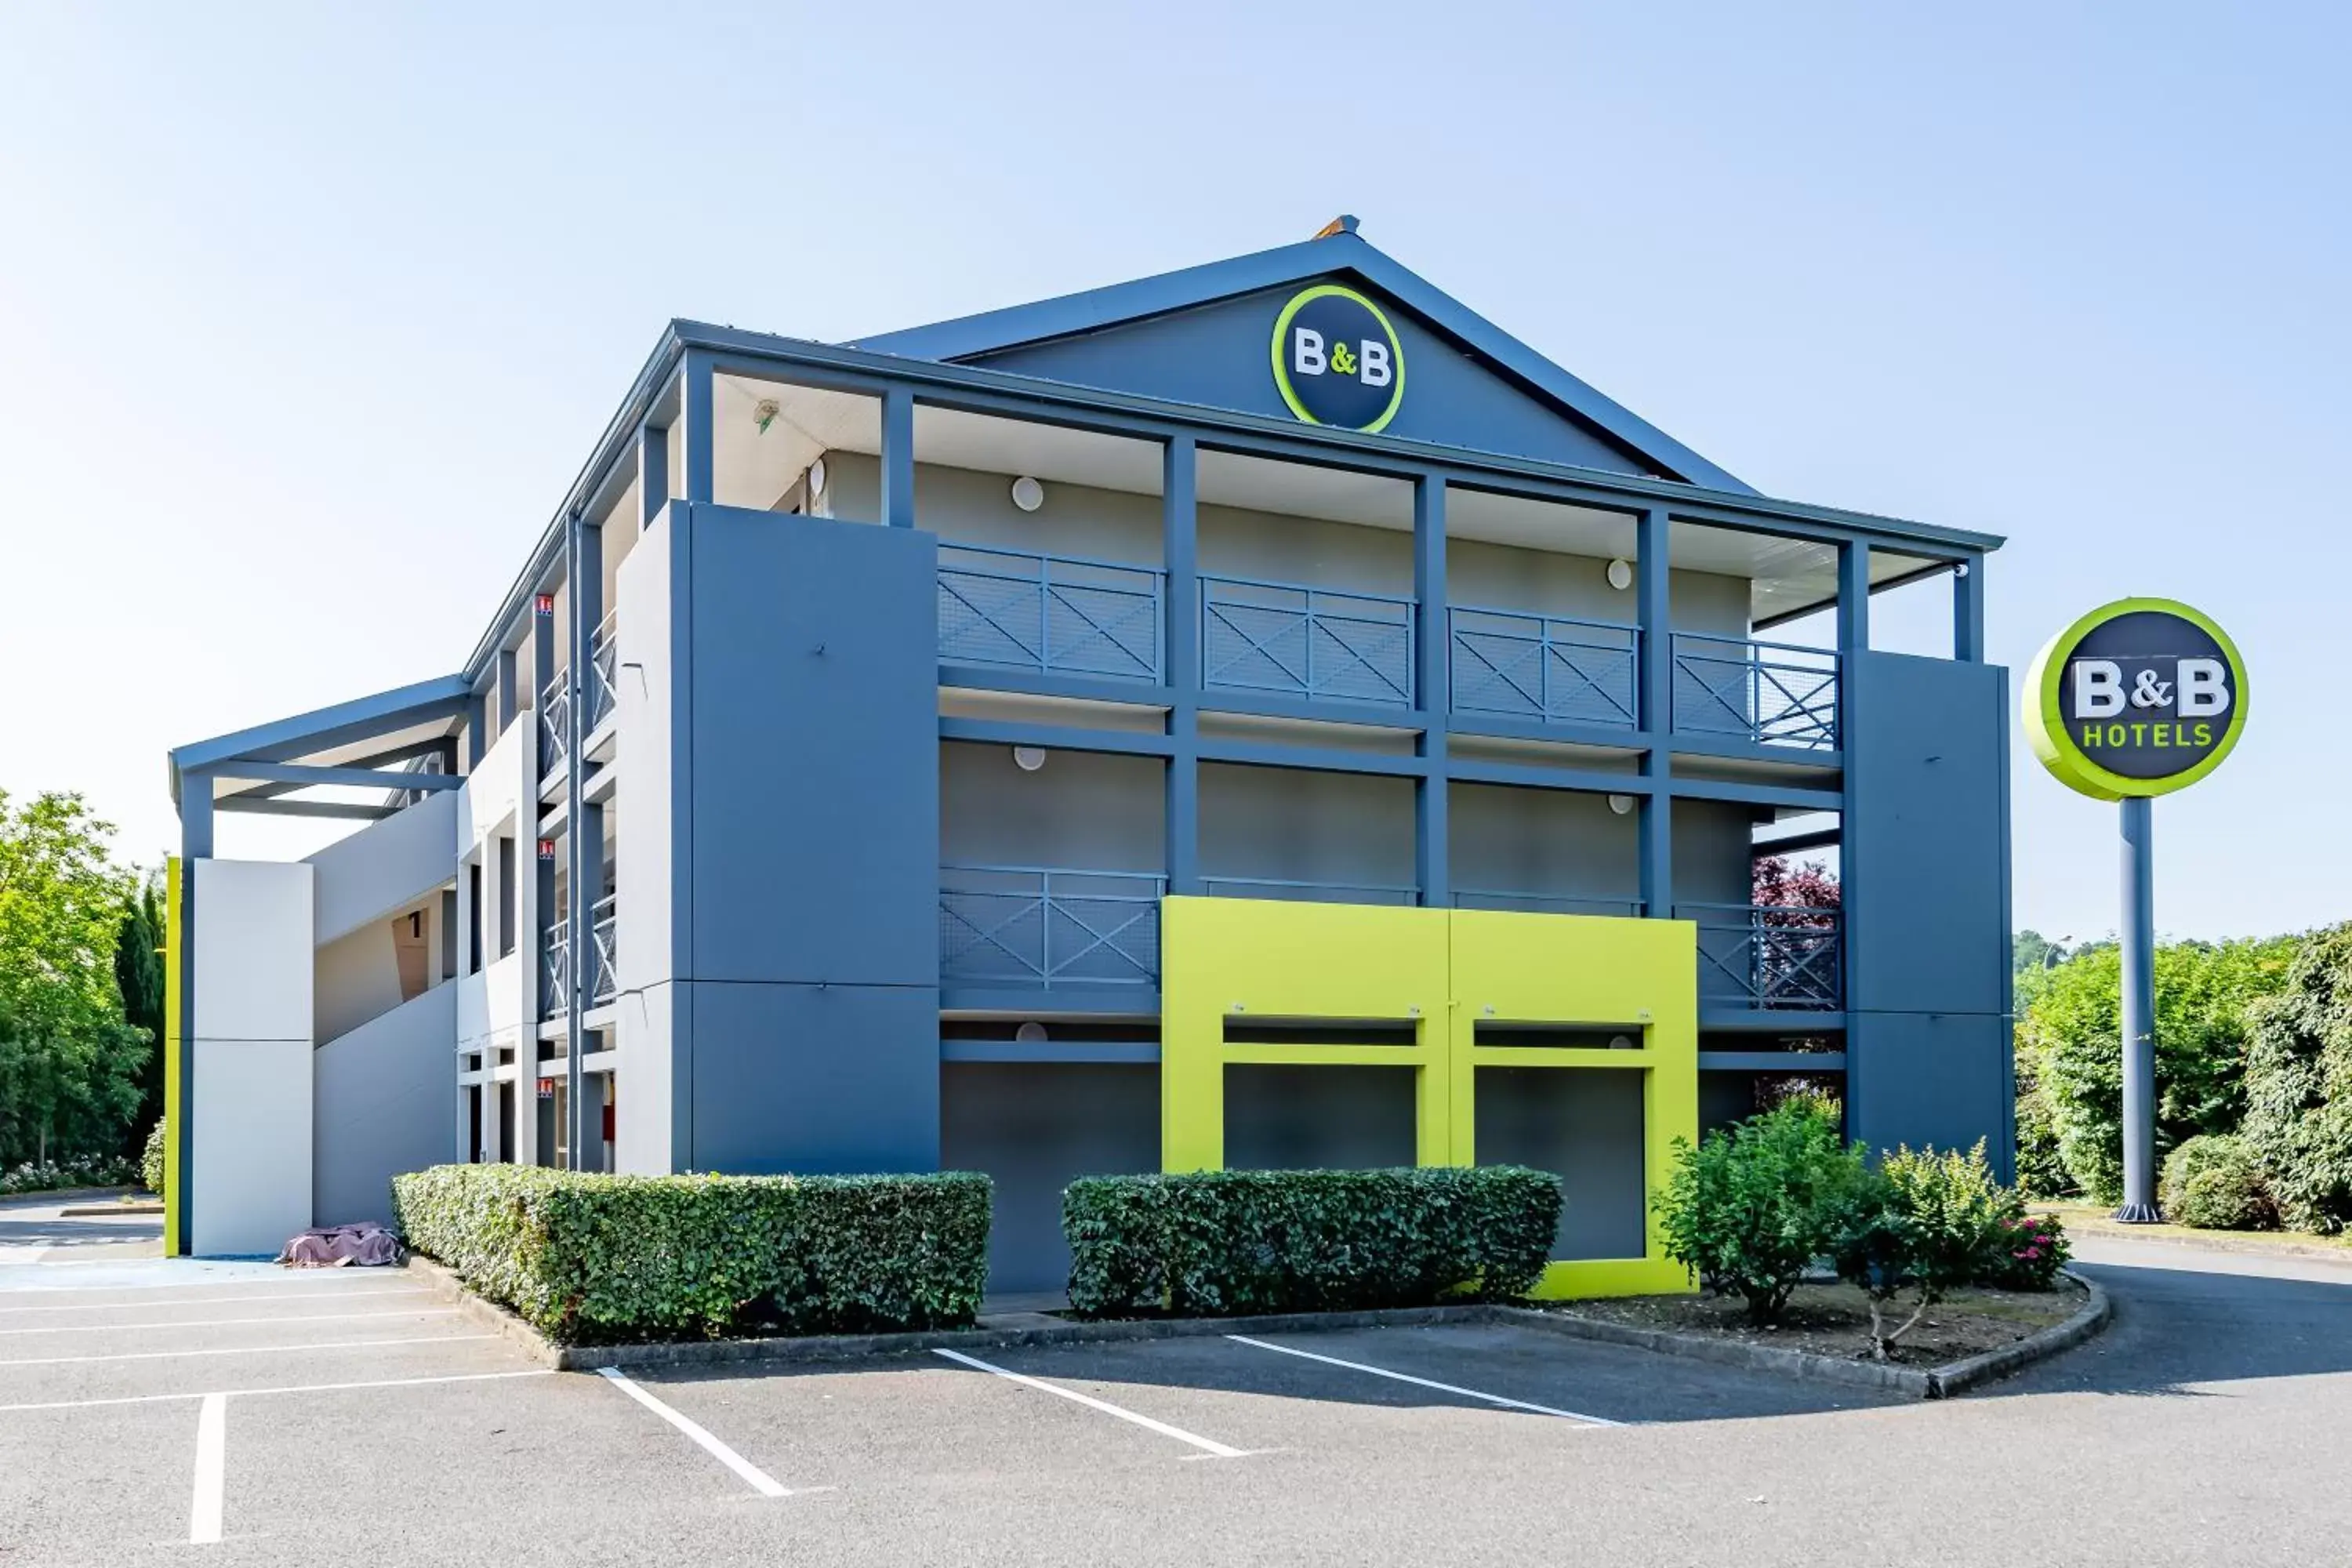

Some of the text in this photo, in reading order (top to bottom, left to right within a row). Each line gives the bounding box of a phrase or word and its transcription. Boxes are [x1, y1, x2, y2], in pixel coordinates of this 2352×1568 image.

[1295, 327, 1392, 387] B&B
[2074, 659, 2230, 719] B&B
[2083, 724, 2212, 746] HOTELS
